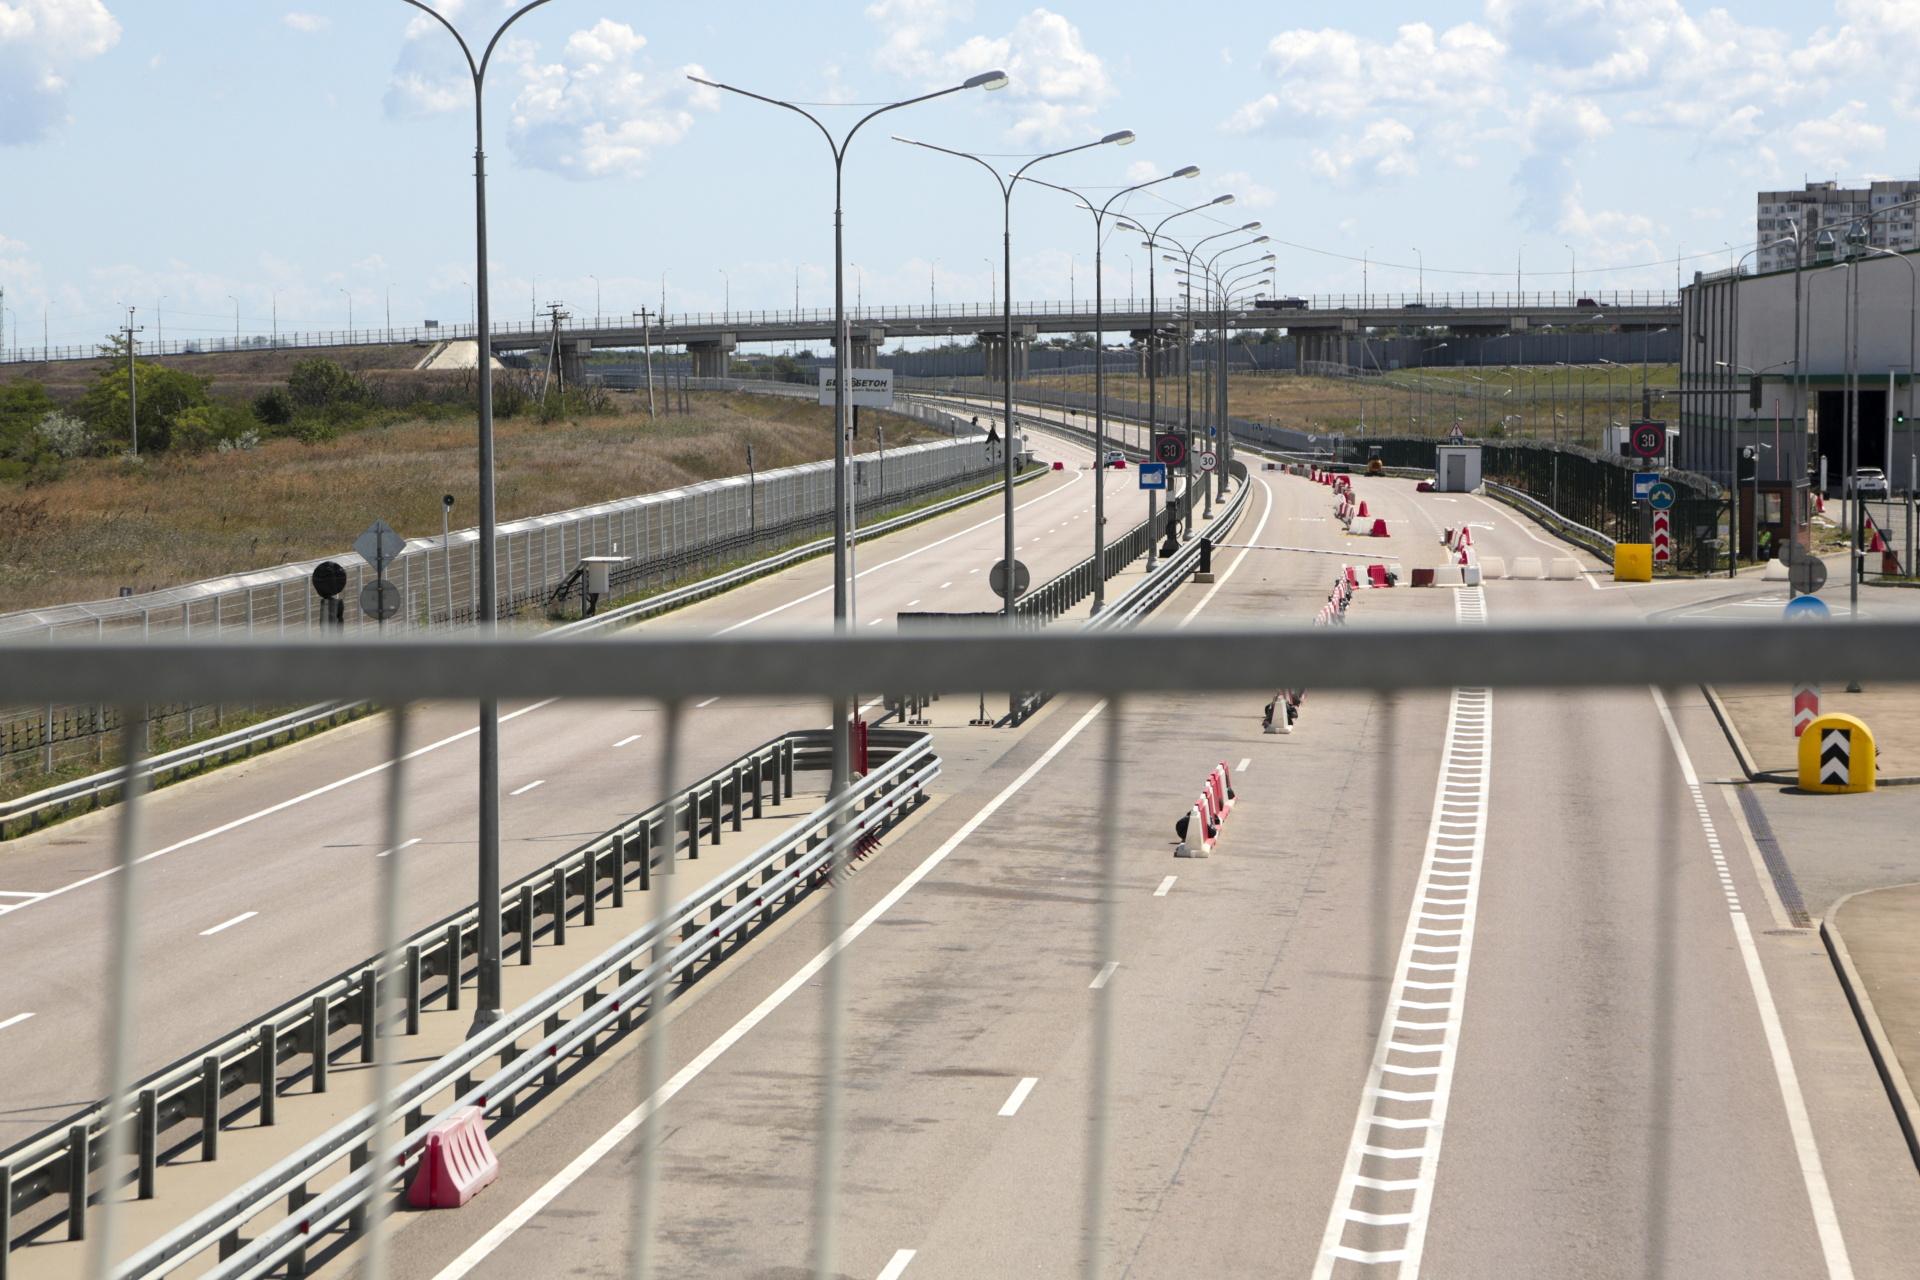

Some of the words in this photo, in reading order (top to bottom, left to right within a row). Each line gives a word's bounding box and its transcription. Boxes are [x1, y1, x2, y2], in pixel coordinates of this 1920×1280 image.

[1641, 434, 1655, 447] 30
[1163, 444, 1176, 457] 30
[1202, 457, 1213, 466] 30
